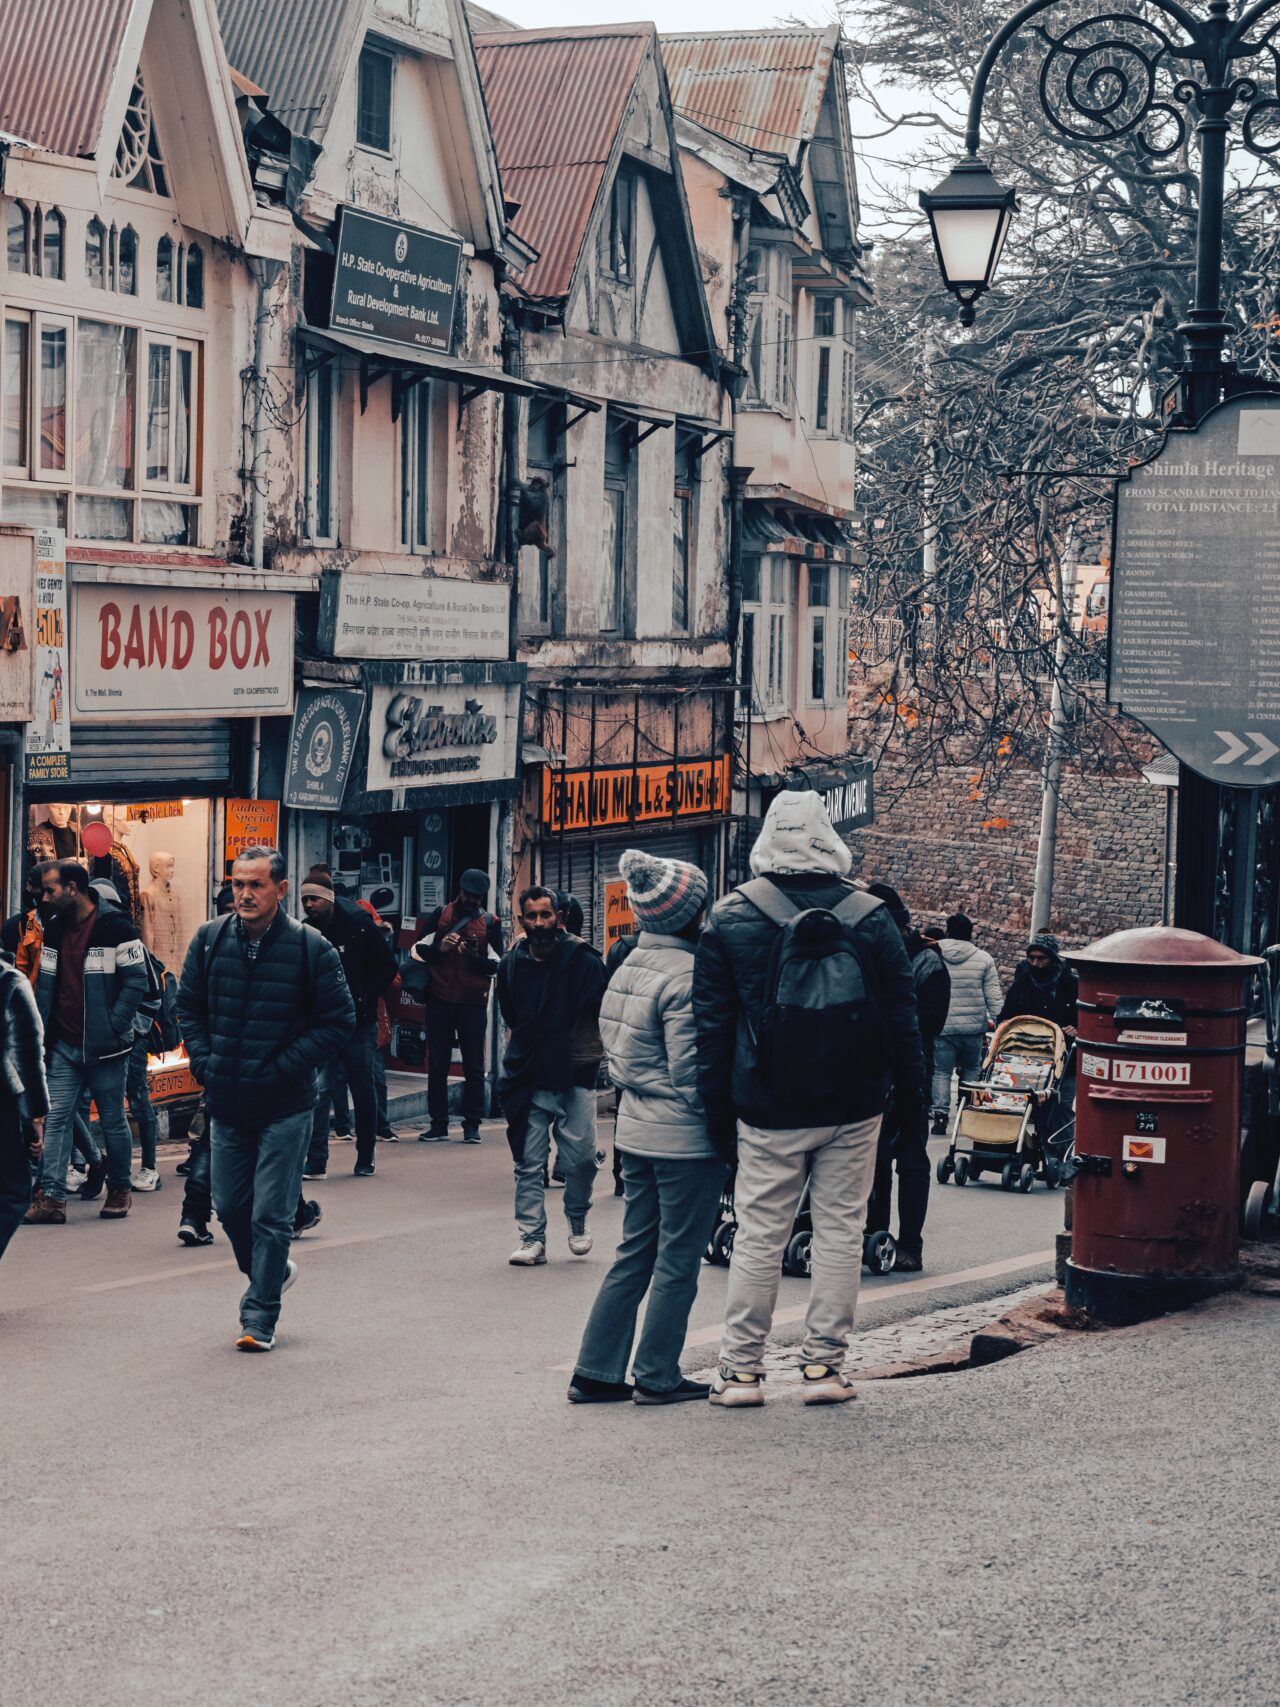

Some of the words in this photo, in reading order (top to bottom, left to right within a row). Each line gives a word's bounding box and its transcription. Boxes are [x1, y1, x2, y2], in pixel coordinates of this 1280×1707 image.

[342, 252, 356, 269] H.P.
[357, 256, 375, 273] State
[376, 261, 417, 285] Co-operative
[418, 273, 452, 295] Agriculture
[393, 284, 399, 298] &
[348, 290, 366, 307] Rural
[367, 294, 409, 319] Development
[410, 304, 426, 321] Bank
[427, 310, 439, 325] Ltd.
[1144, 461, 1198, 476] Shimla
[1204, 461, 1274, 480] Heritage
[1125, 488, 1156, 497] FROM
[1158, 488, 1207, 497] SCANDAL
[1209, 488, 1243, 497] POINT
[1244, 488, 1259, 497] TO
[1144, 502, 1186, 512] TOTAL
[1189, 502, 1259, 513] DISTANCE:
[345, 594, 358, 605] The
[359, 596, 372, 607] H.P.
[374, 596, 390, 608] State
[412, 600, 445, 613] Agriculture
[446, 602, 451, 612] &
[452, 603, 468, 613] Rural
[99, 602, 195, 671] BAND
[208, 606, 272, 670] BOX
[343, 623, 365, 636] हिमाचल
[30, 756, 36, 766] A
[36, 755, 67, 766] COMPLETE
[29, 769, 49, 779] FAMILY
[50, 767, 68, 778] STORE
[306, 780, 324, 791] SHIMLA
[613, 774, 652, 818] MULL
[654, 784, 664, 812] &
[666, 769, 704, 812] SONS
[163, 802, 181, 818] Chek
[230, 802, 266, 814] Ladies
[826, 786, 844, 824] PARK
[844, 779, 867, 820] AVENUE
[235, 813, 275, 824] Special
[426, 814, 441, 833] hp
[227, 836, 275, 848] SPECIAL
[425, 850, 441, 869] hp
[1114, 1063, 1188, 1081] 171001
[155, 1075, 184, 1093] GENTS
